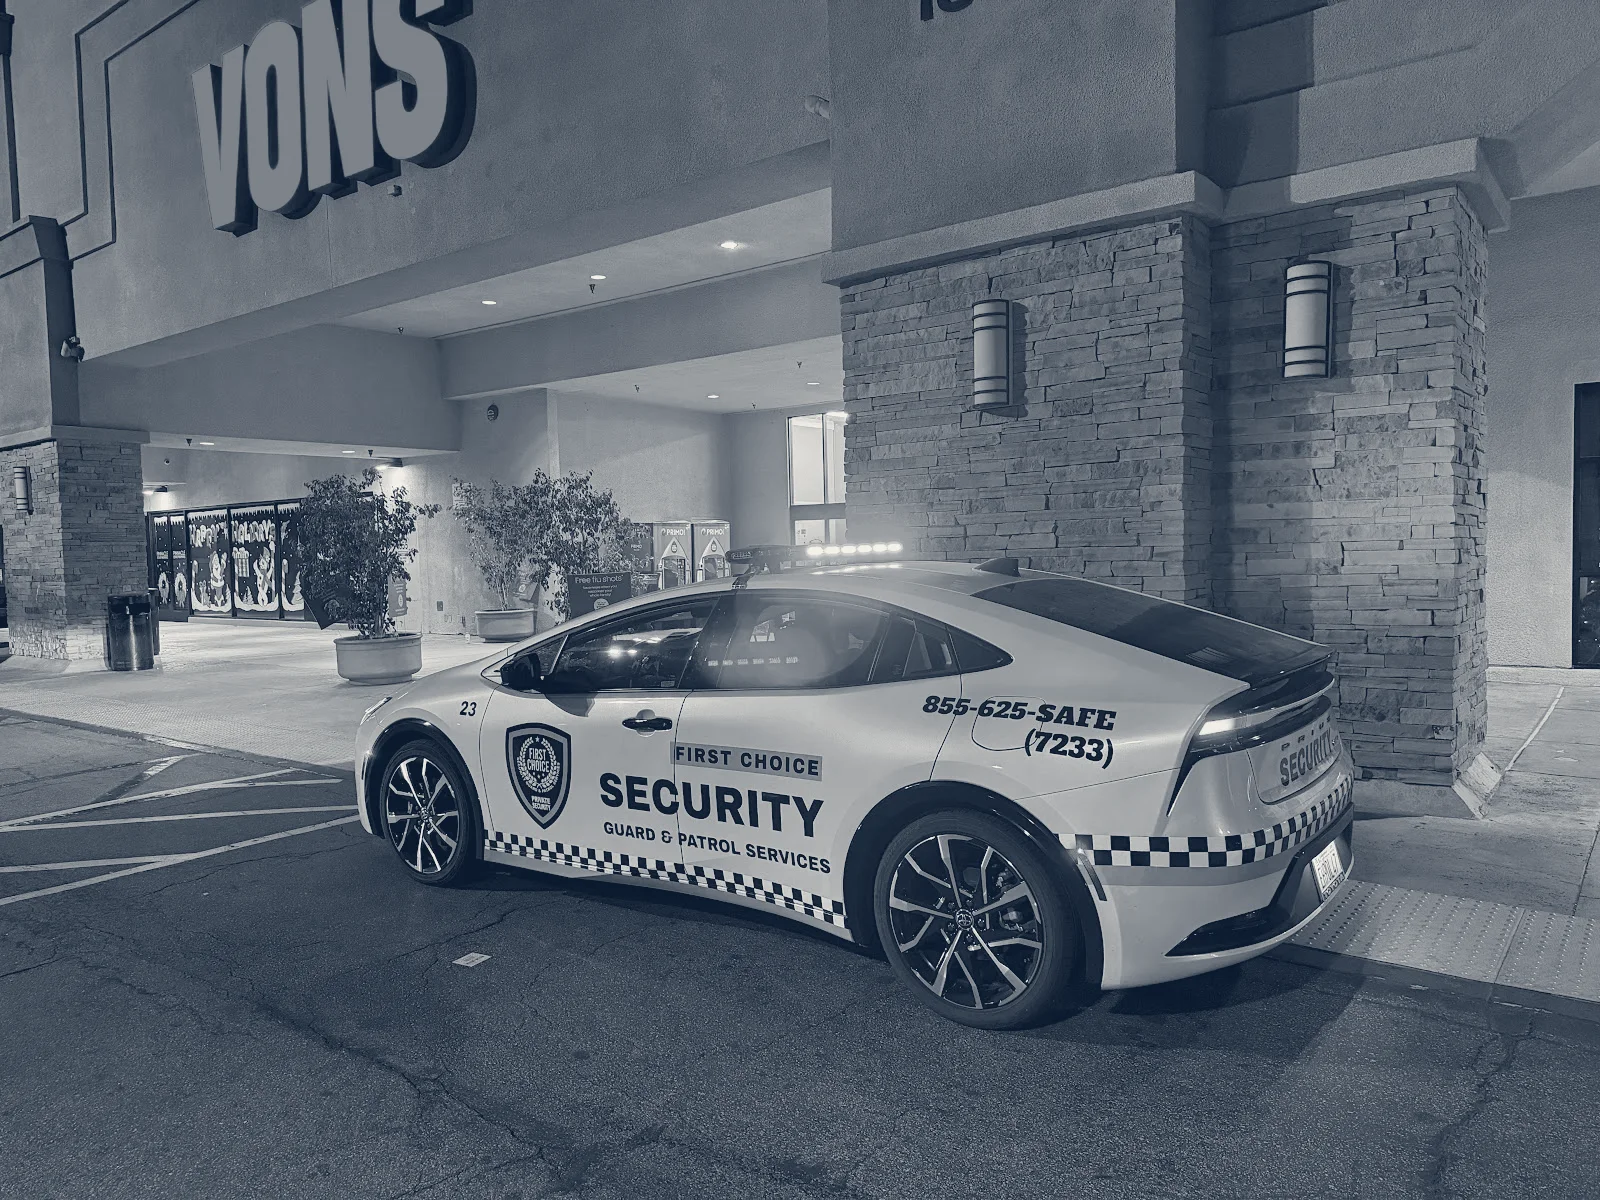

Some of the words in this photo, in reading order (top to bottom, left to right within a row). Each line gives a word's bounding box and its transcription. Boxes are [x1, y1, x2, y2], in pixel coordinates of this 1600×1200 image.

[191, 0, 460, 233] VONS
[188, 523, 220, 549] HAPPY
[592, 575, 601, 583] flu
[460, 701, 477, 716] 23
[922, 696, 1117, 731] 855-625-SAFE
[1281, 715, 1331, 751] PRIUS
[528, 748, 547, 760] FIRST
[675, 746, 732, 766] FIRST
[740, 752, 809, 776] CHOICE
[1024, 728, 1114, 769] (7233)
[1280, 727, 1332, 786] SECURITY
[527, 759, 550, 772] CHOICE
[531, 796, 551, 805] PRIVATE
[532, 803, 551, 811] SECURITY
[599, 772, 824, 838] SECURITY
[603, 821, 656, 841] GUARD
[661, 830, 673, 844] &
[678, 832, 741, 855] PATROL
[745, 843, 831, 874] SERVICES
